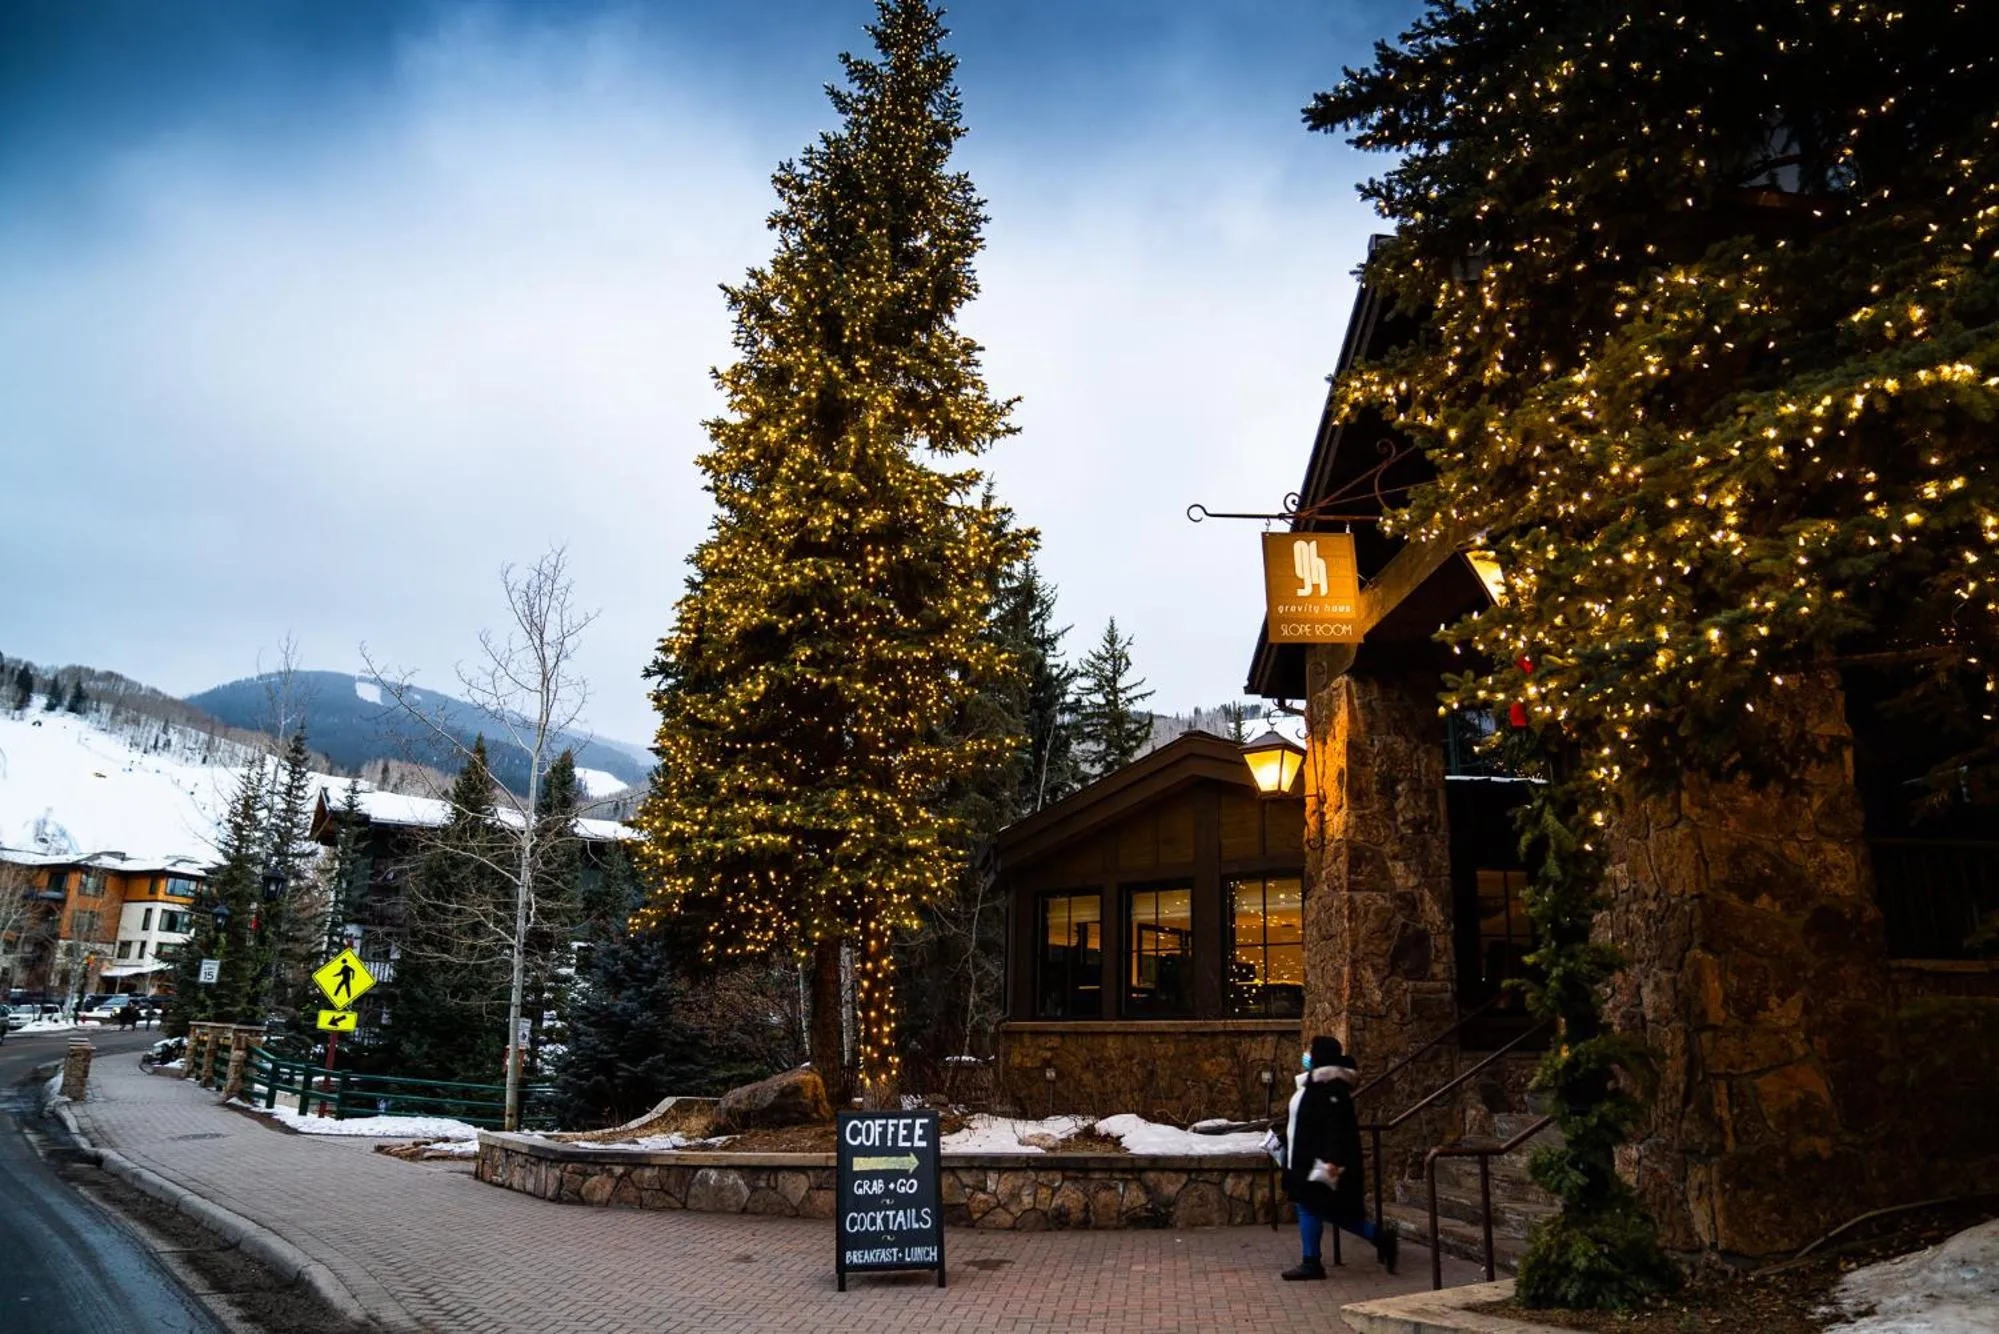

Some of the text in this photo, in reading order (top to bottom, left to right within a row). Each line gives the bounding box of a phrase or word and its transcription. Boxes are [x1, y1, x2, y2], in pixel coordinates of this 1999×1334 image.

[1278, 603, 1320, 614] gravity
[1280, 623, 1352, 636] SLOPE ROOM
[204, 971, 214, 980] 15
[845, 1119, 929, 1147] COFFEE
[853, 1179, 884, 1195] GRAB
[896, 1179, 918, 1194] GO
[845, 1208, 932, 1233] COCKTAILS
[845, 1247, 898, 1265] BREAKFAST
[904, 1246, 938, 1262] LUNCH
